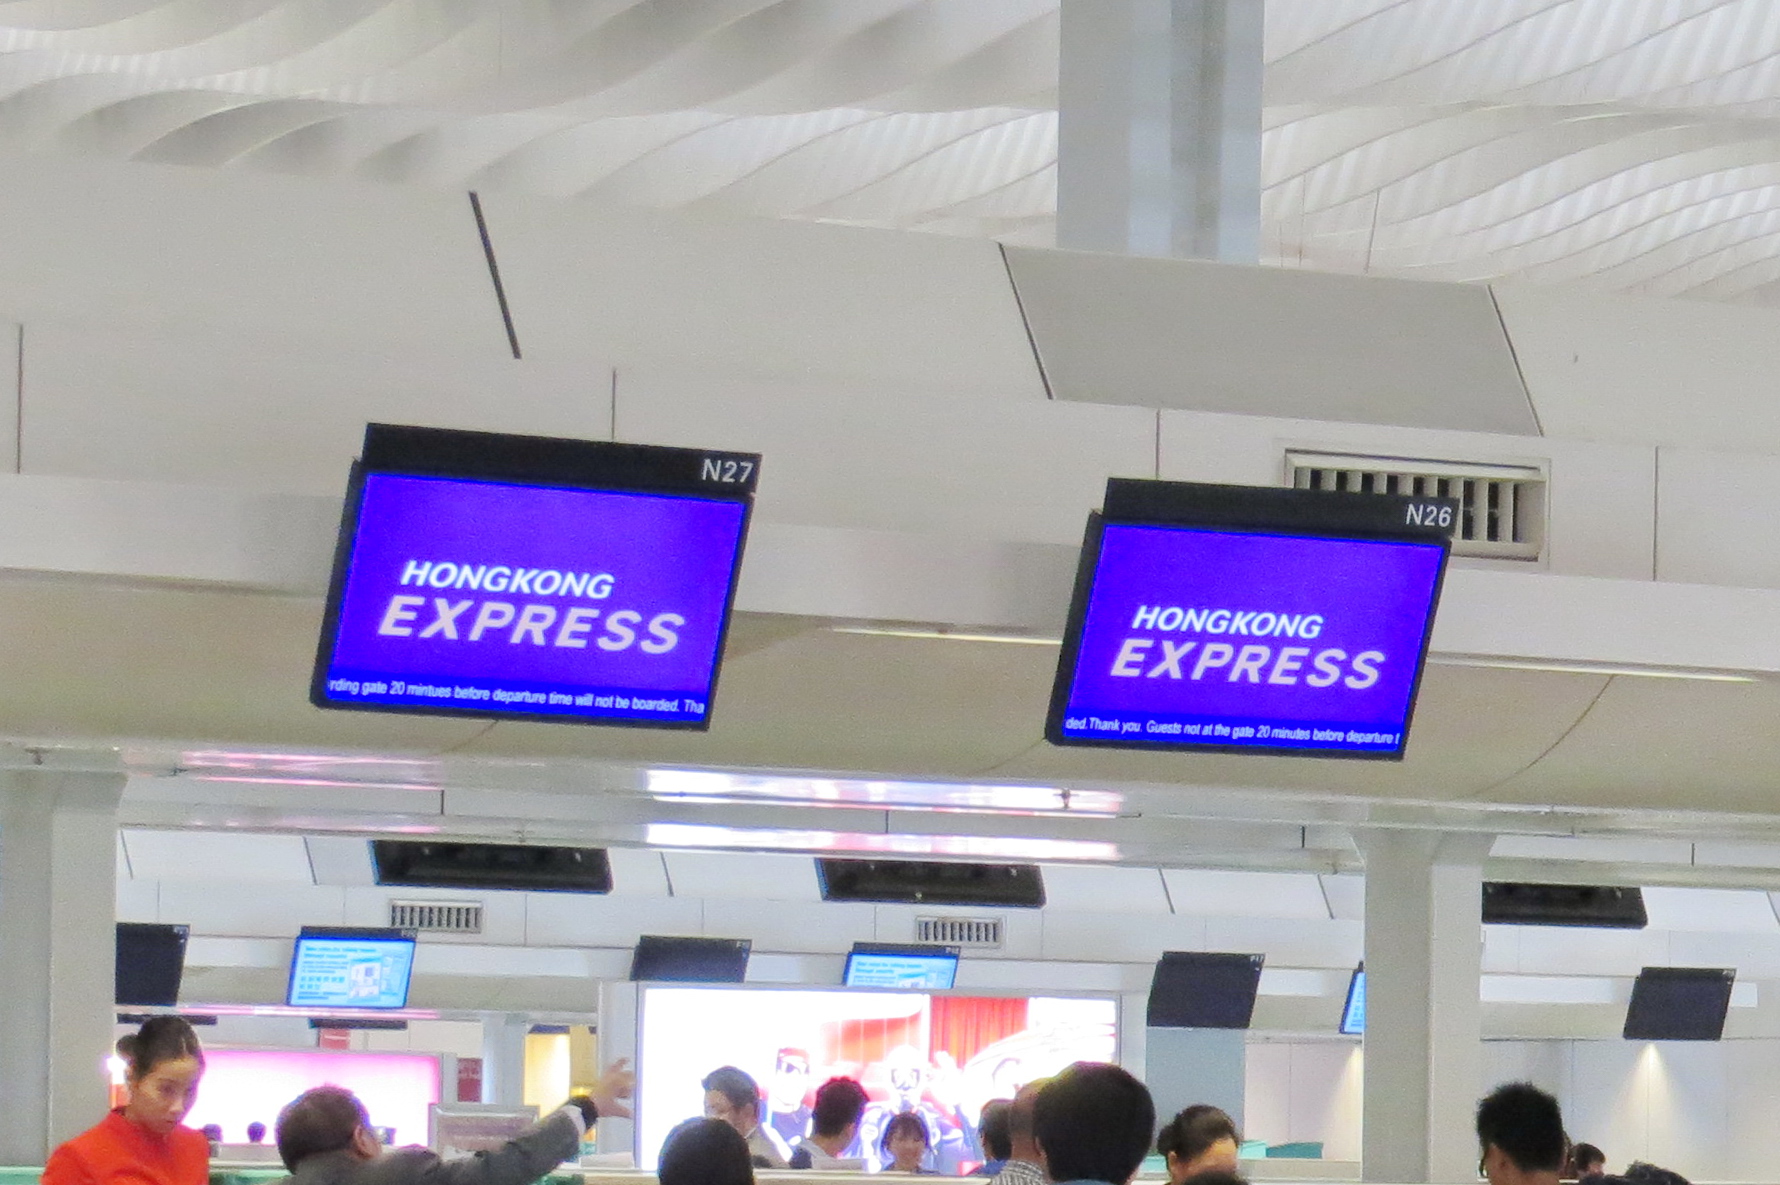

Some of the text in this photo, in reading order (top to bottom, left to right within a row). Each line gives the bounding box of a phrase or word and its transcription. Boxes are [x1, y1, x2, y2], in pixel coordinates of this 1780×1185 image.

[701, 458, 754, 484] N27
[1406, 503, 1452, 528] N26
[400, 560, 615, 599] HONGKONG
[377, 595, 685, 654] EXPRESS
[1131, 604, 1324, 640] HONGKONG
[1110, 639, 1385, 689] EXPRESS
[362, 680, 388, 696] gate
[390, 681, 405, 694] 20
[454, 685, 490, 700] before
[493, 688, 547, 704] departure
[549, 691, 573, 706] time
[576, 693, 593, 706] will
[595, 695, 613, 708] not
[615, 695, 630, 708] be
[632, 697, 680, 712] boarded.
[1089, 717, 1120, 732] Thank
[1121, 720, 1142, 734] you.
[1146, 720, 1182, 733] Guests
[1184, 723, 1200, 735] not
[1202, 724, 1213, 736] at
[1214, 723, 1230, 736] the
[1232, 726, 1255, 739] gate
[1256, 725, 1271, 738] 20
[1312, 728, 1345, 742] before
[1346, 730, 1394, 744] departure
